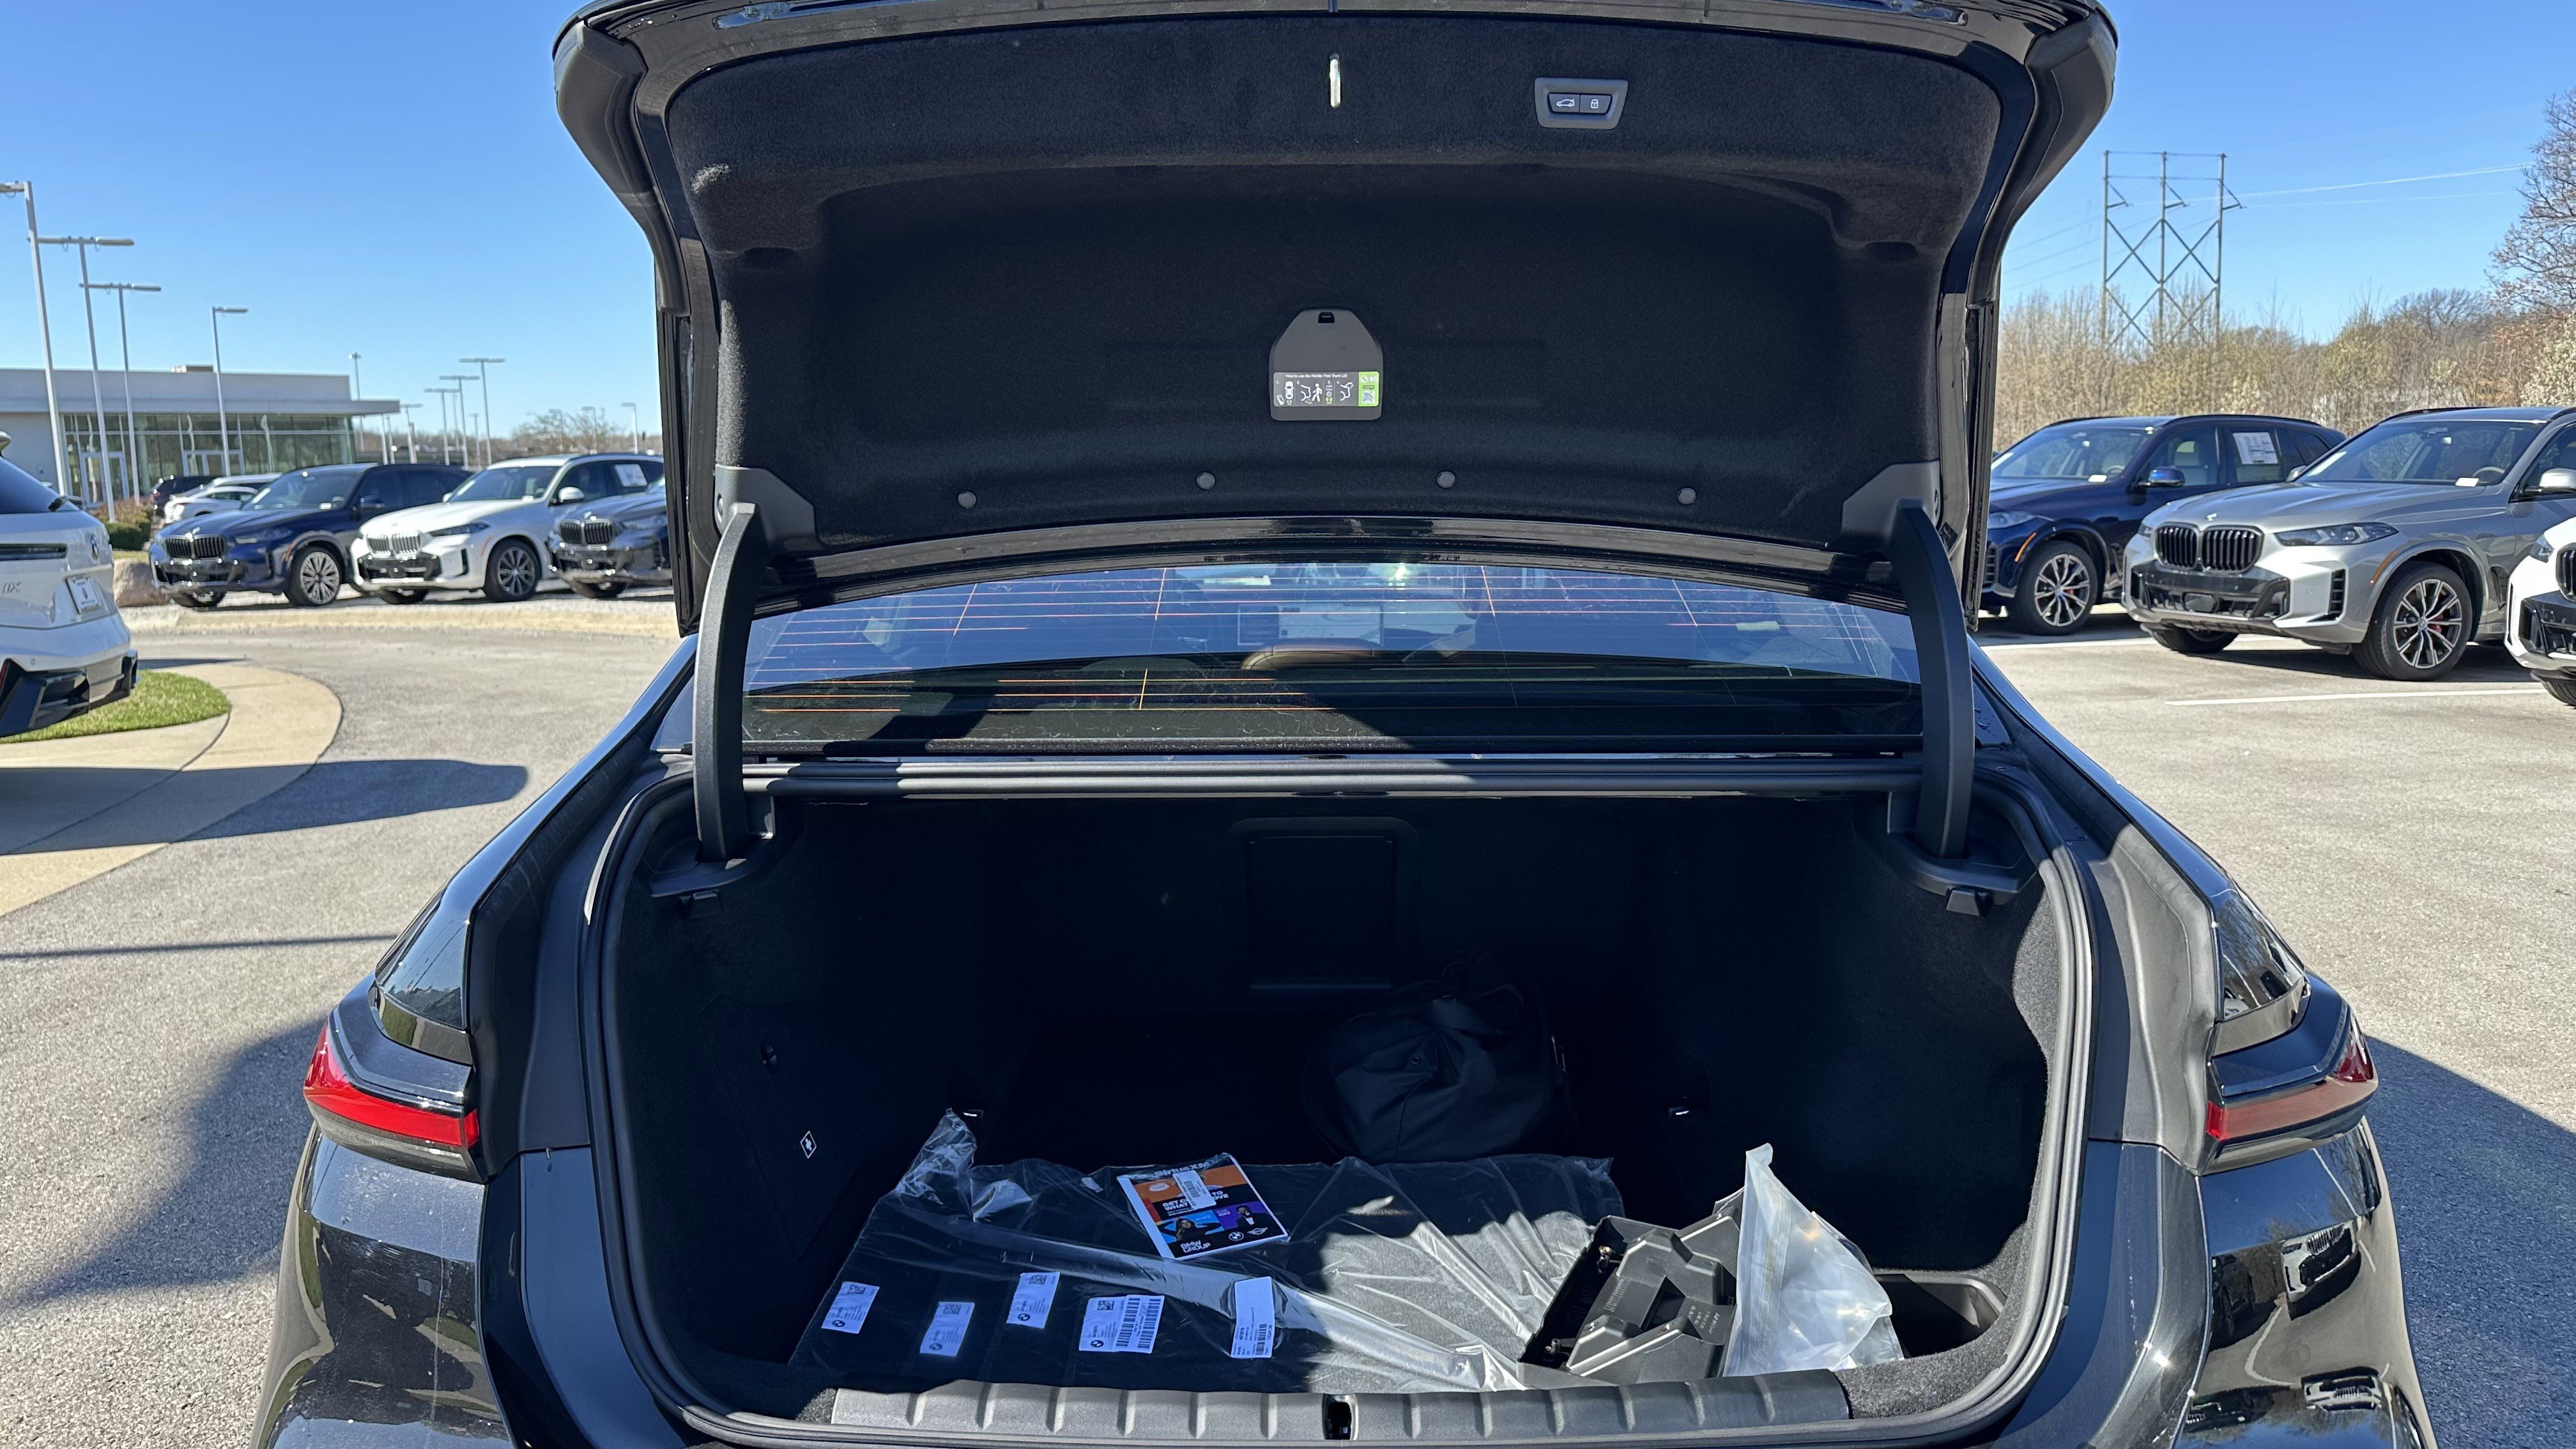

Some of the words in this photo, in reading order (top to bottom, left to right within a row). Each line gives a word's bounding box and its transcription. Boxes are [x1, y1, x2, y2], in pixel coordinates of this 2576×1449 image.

[1164, 1202, 1188, 1211] WHAT
[1181, 1240, 1201, 1249] BMW
[1183, 1243, 1211, 1253] GROUP
